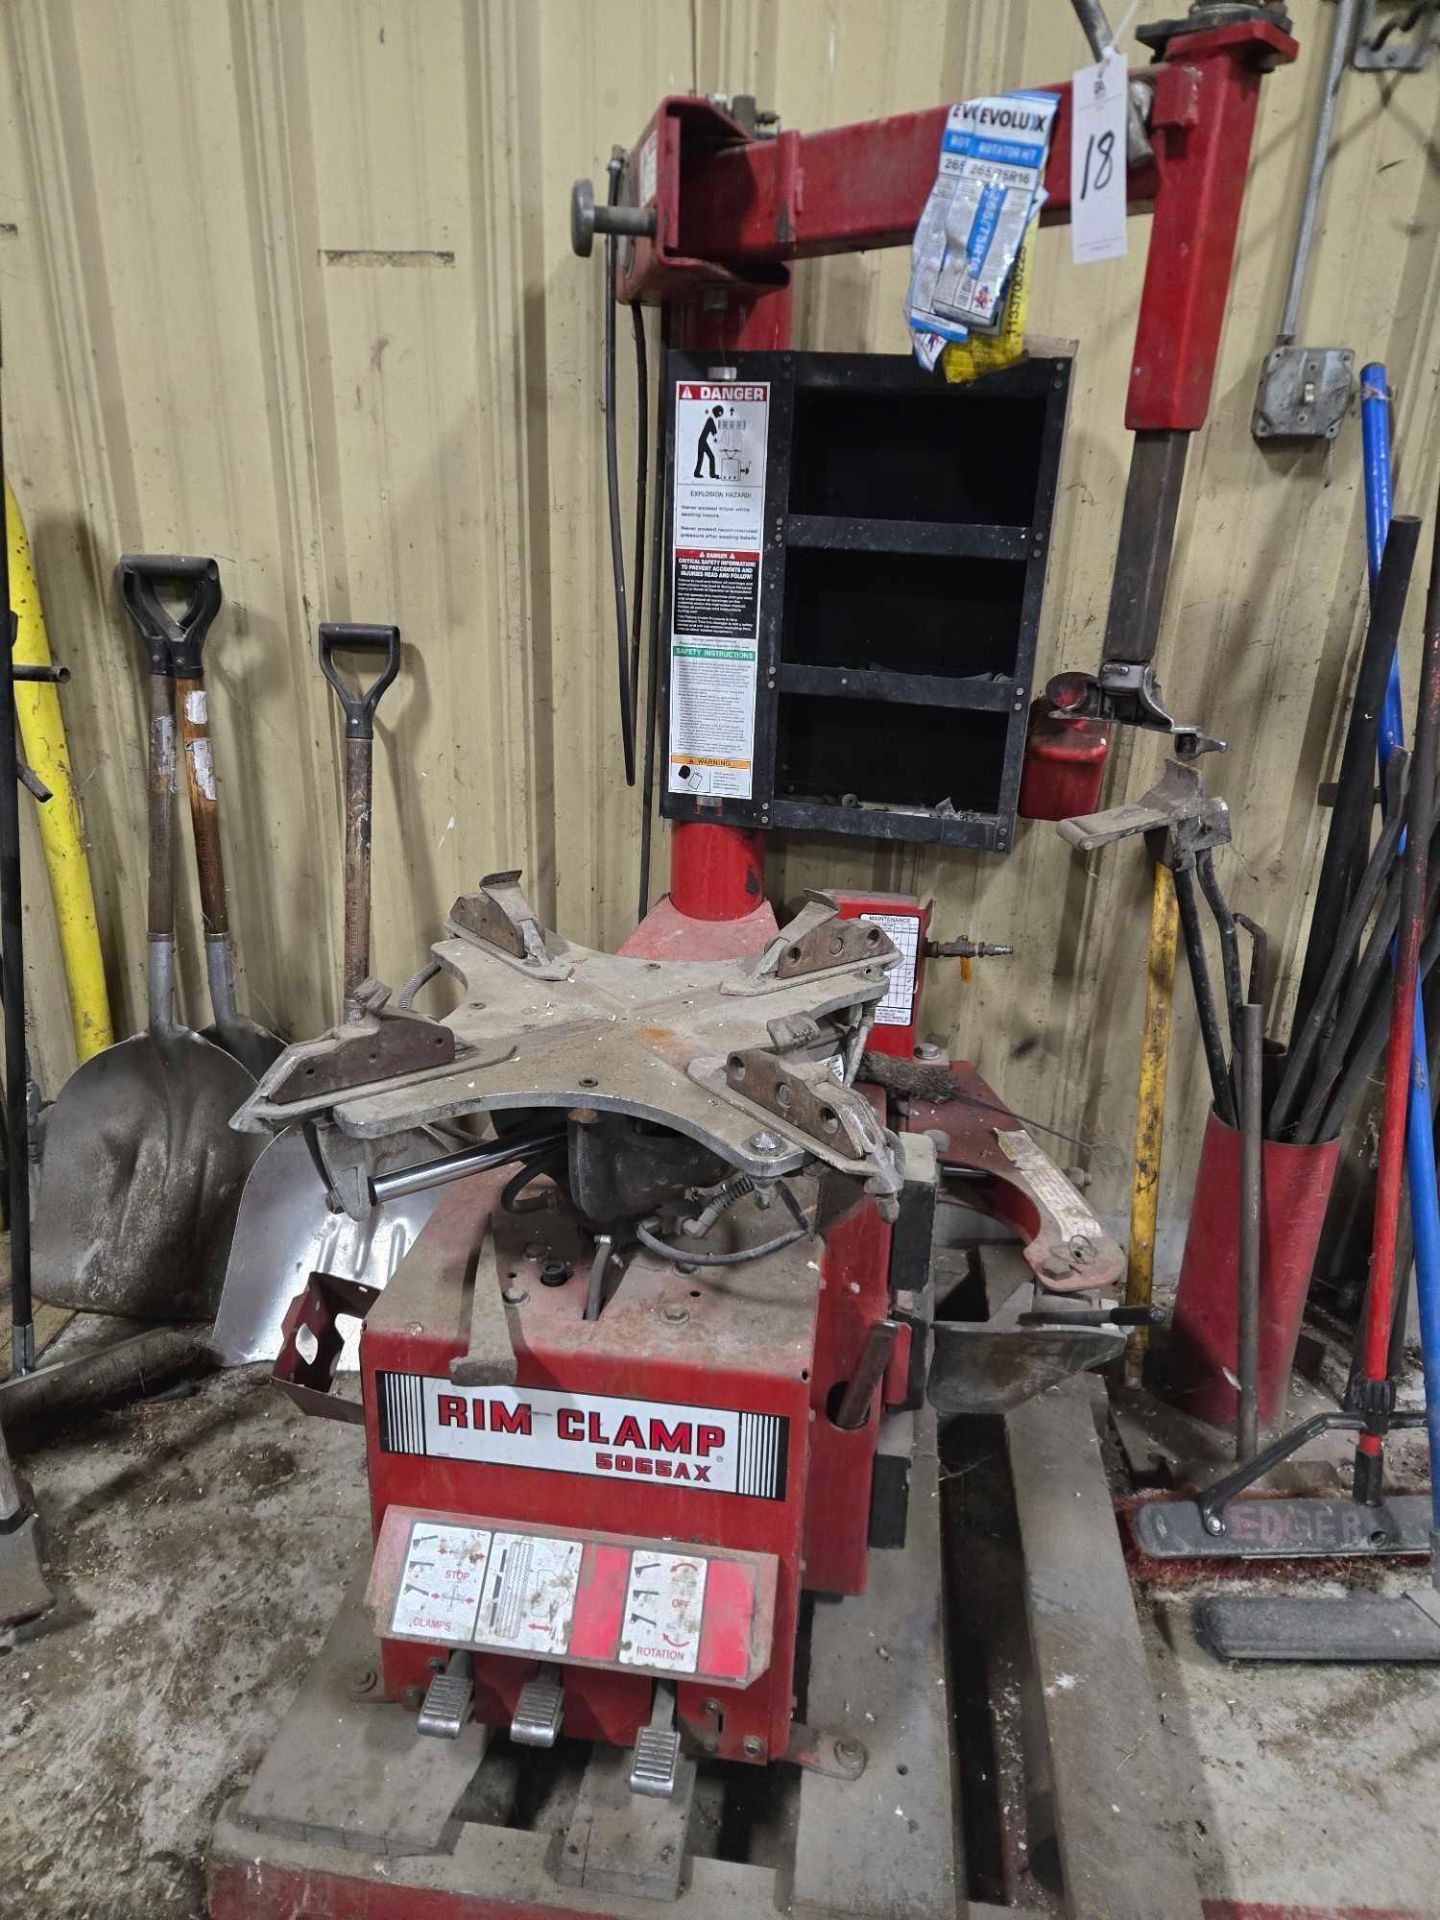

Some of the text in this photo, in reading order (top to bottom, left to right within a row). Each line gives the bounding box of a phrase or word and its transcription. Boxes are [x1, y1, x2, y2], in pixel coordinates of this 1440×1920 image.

[1080, 129, 1115, 200] 18
[700, 386, 764, 400] DANGER
[690, 490, 723, 499] EXPLOSION
[676, 647, 754, 660] SAFETY INSTRUCTIONS
[697, 758, 731, 767] WARNING
[869, 915, 911, 924] MAINTENANCE
[437, 1393, 726, 1458] RIM CLAMP
[595, 1451, 712, 1483] 5065AX
[444, 1569, 470, 1581] STOP
[671, 1598, 691, 1610] OFF
[412, 1617, 453, 1632] CLAMPS
[635, 1645, 685, 1662] ROTATION
